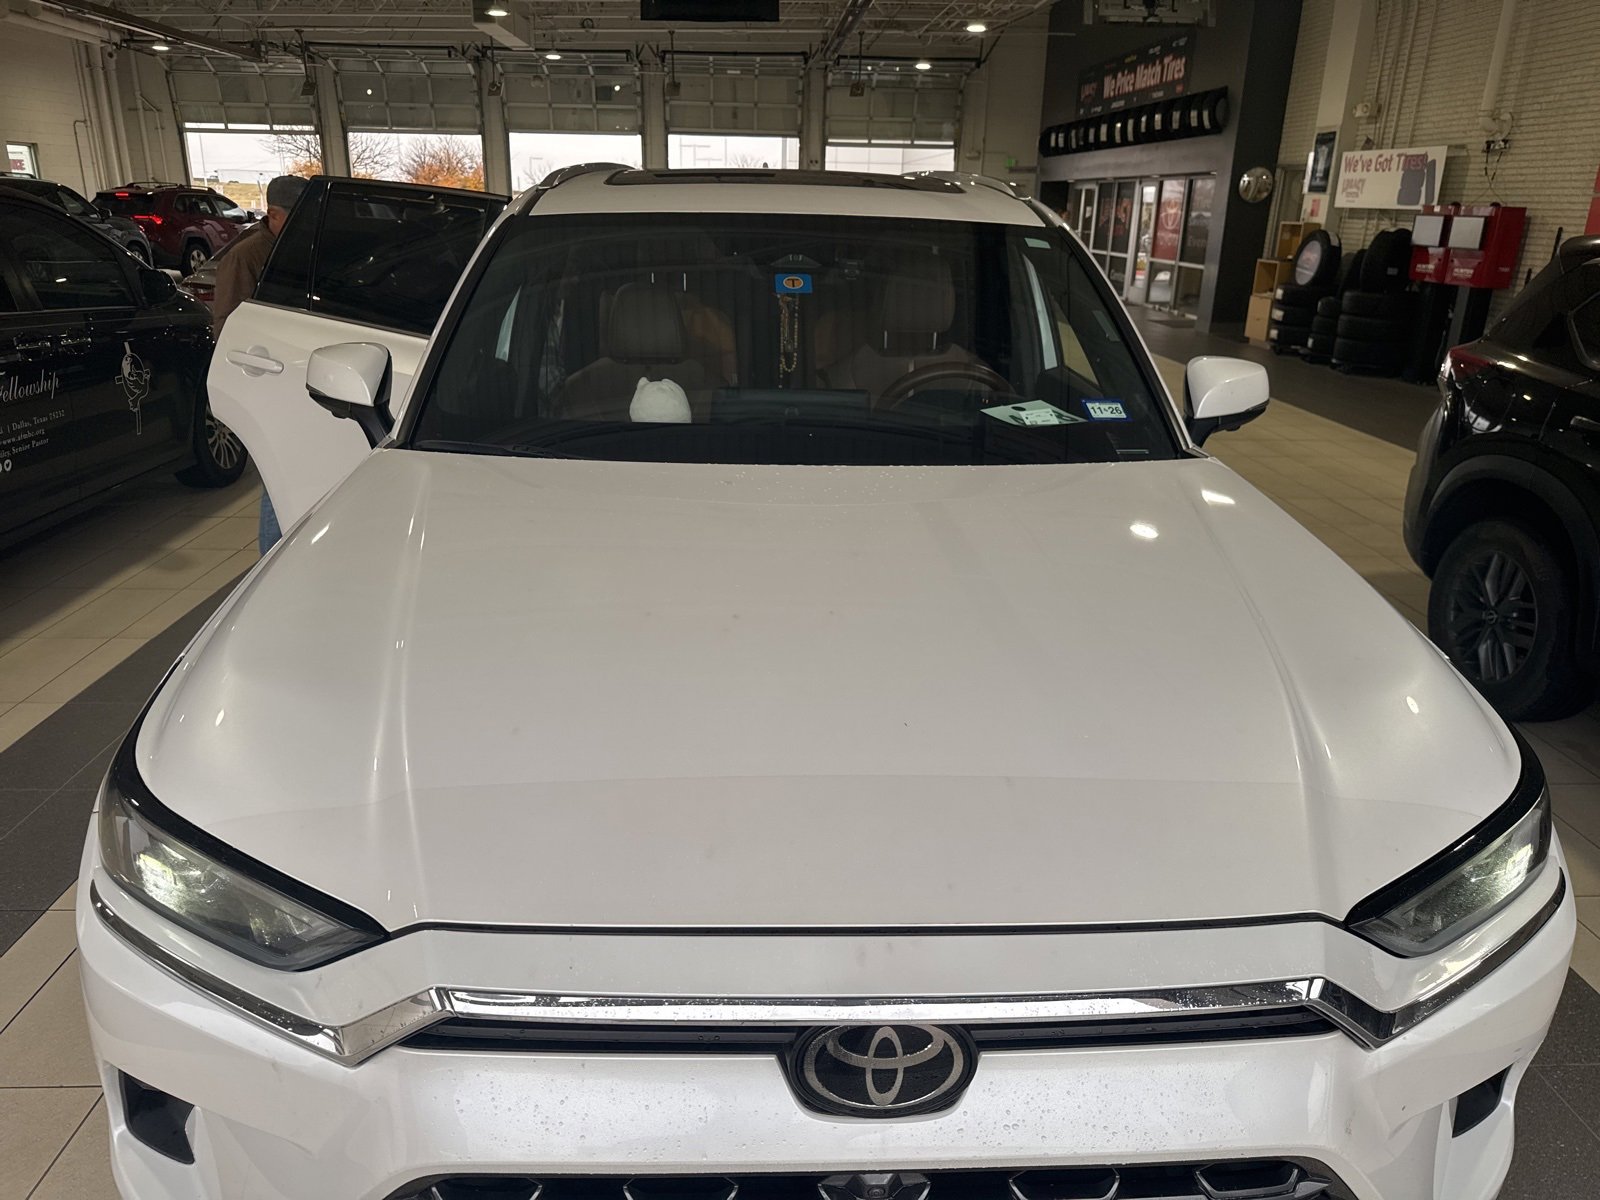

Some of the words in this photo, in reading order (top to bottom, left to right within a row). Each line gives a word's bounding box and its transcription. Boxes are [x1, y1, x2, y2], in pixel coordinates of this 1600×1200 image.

[1103, 75, 1115, 99] We
[1115, 69, 1135, 96] Price
[1135, 59, 1161, 89] Match
[1163, 53, 1186, 82] Tires
[1344, 155, 1373, 174] We've
[1374, 153, 1394, 173] Got
[12, 420, 32, 431] Dallas,
[33, 416, 48, 425] Texas
[12, 443, 31, 455] Senior
[31, 438, 49, 448] Pastor
